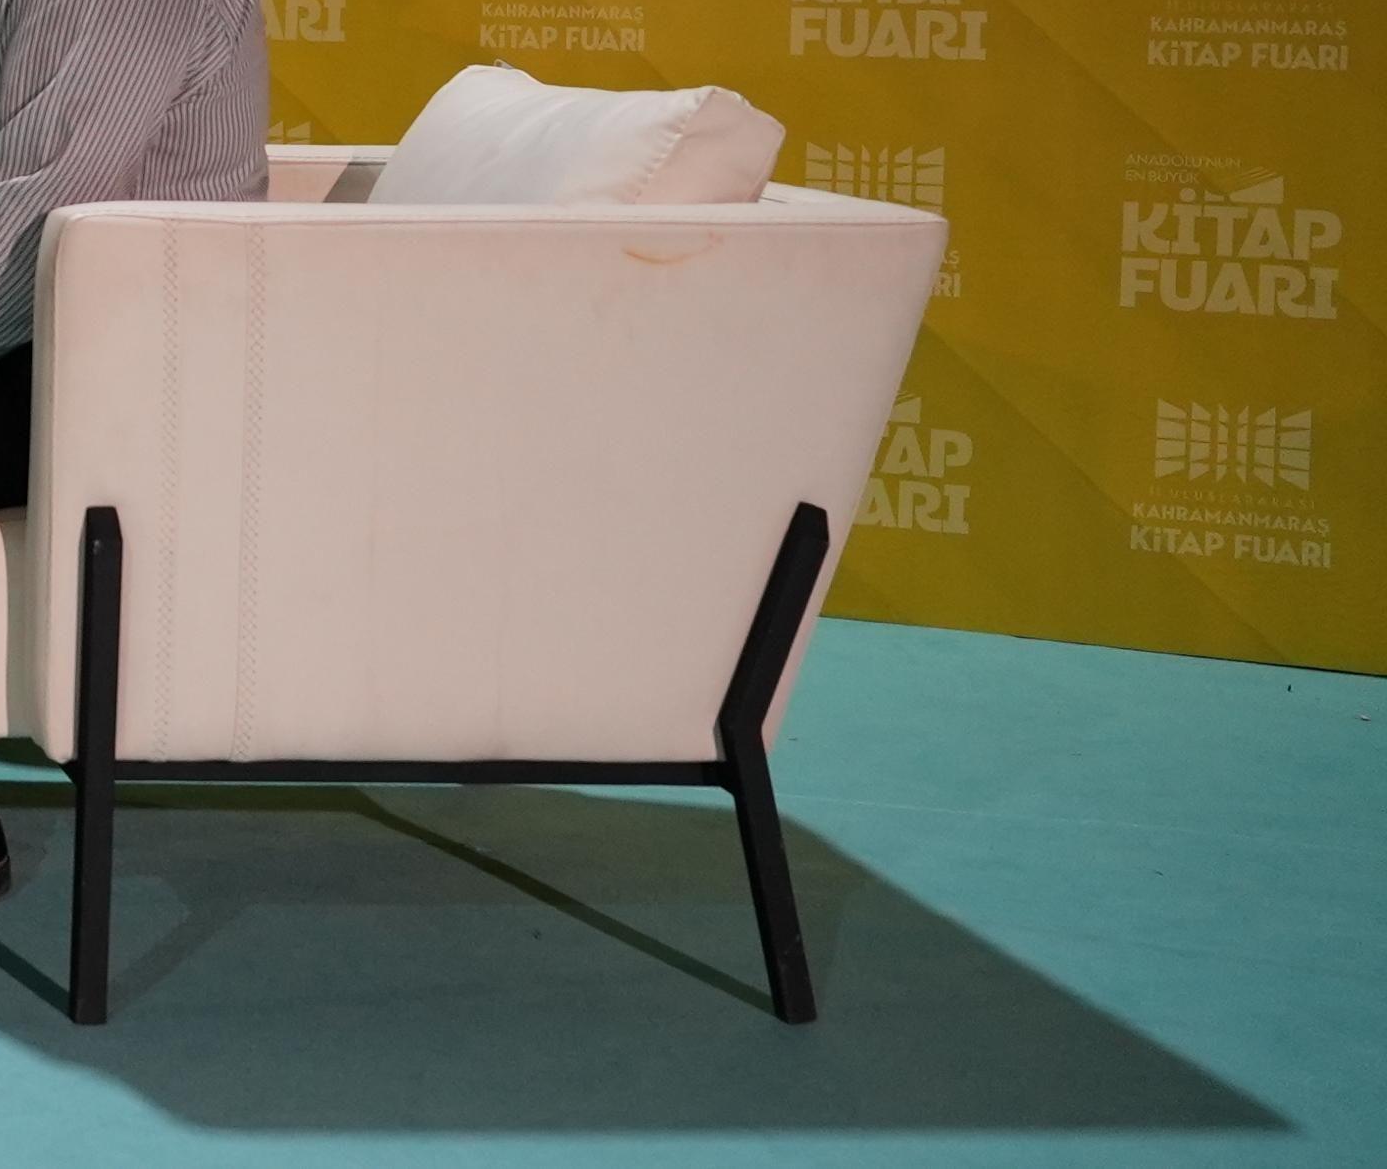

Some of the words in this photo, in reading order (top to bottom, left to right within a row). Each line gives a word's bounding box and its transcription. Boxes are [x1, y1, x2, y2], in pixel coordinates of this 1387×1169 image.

[565, 26, 646, 52] FUARI
[790, 6, 988, 61] FUARI
[1250, 43, 1349, 71] FUARI
[1122, 188, 1342, 260] KİTAP
[1119, 256, 1340, 319] FUARI
[852, 477, 971, 534] ARI
[1234, 534, 1332, 569] FUARI
